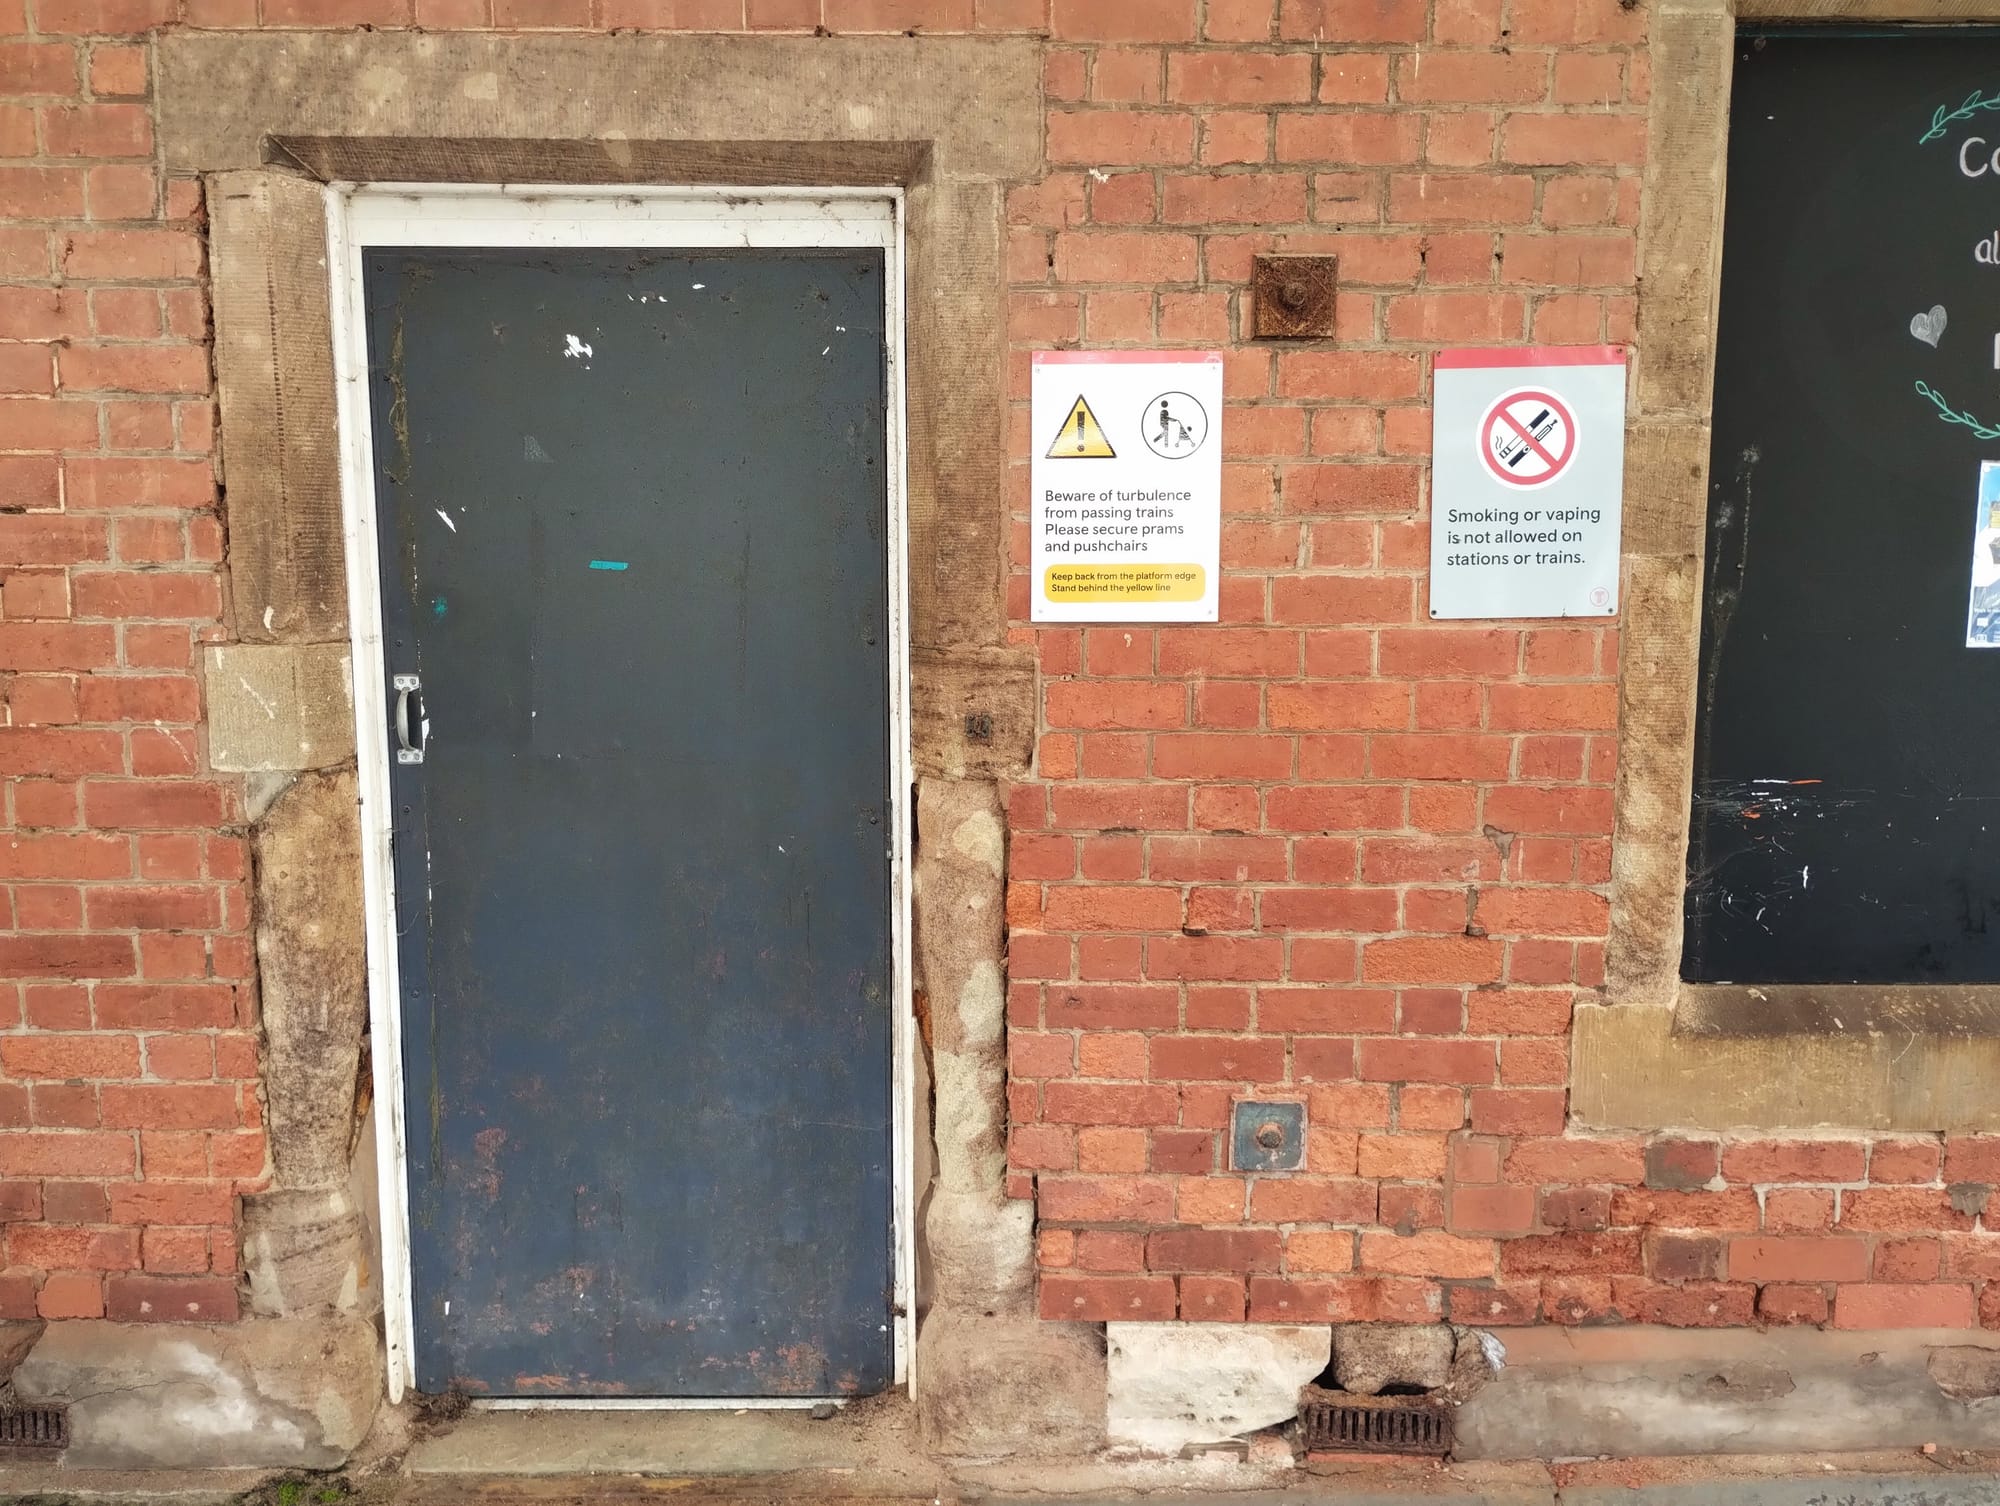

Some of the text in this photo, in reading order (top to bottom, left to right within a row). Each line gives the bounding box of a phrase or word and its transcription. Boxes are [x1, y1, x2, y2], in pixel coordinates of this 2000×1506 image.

[1046, 488, 1192, 502] Beware of turbulence
[1045, 505, 1174, 522] from passing trains
[1448, 506, 1601, 526] Smoking or vaping
[1046, 523, 1184, 538] Please secure prams
[1448, 528, 1583, 545] is not allowed on
[1045, 539, 1148, 555] and pushchairs
[1447, 549, 1586, 567] stations or trains.
[1052, 571, 1197, 583] Keep back from the platform edge
[1052, 582, 1172, 594] Stand behind the yellow line
